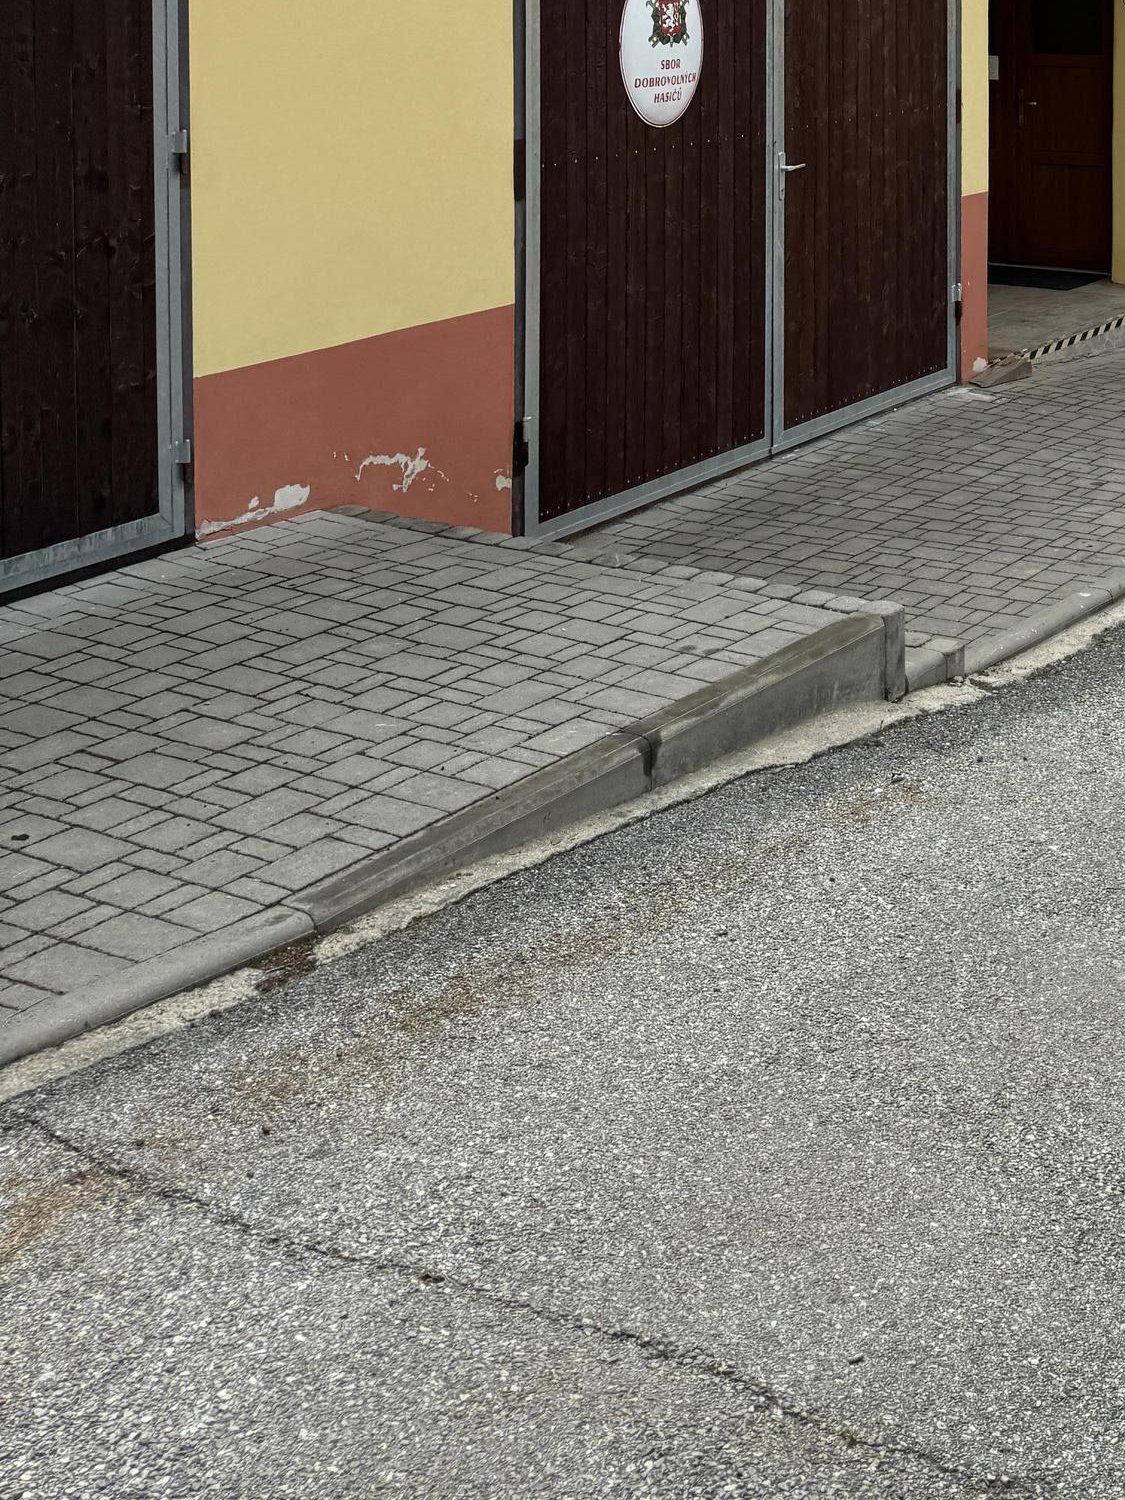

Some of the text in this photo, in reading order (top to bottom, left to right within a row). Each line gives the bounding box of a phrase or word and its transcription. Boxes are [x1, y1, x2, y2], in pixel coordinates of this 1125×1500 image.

[660, 58, 681, 70] SBOR
[634, 71, 697, 88] DOBROVOLNÝCH
[653, 87, 682, 103] HASIČŮ
